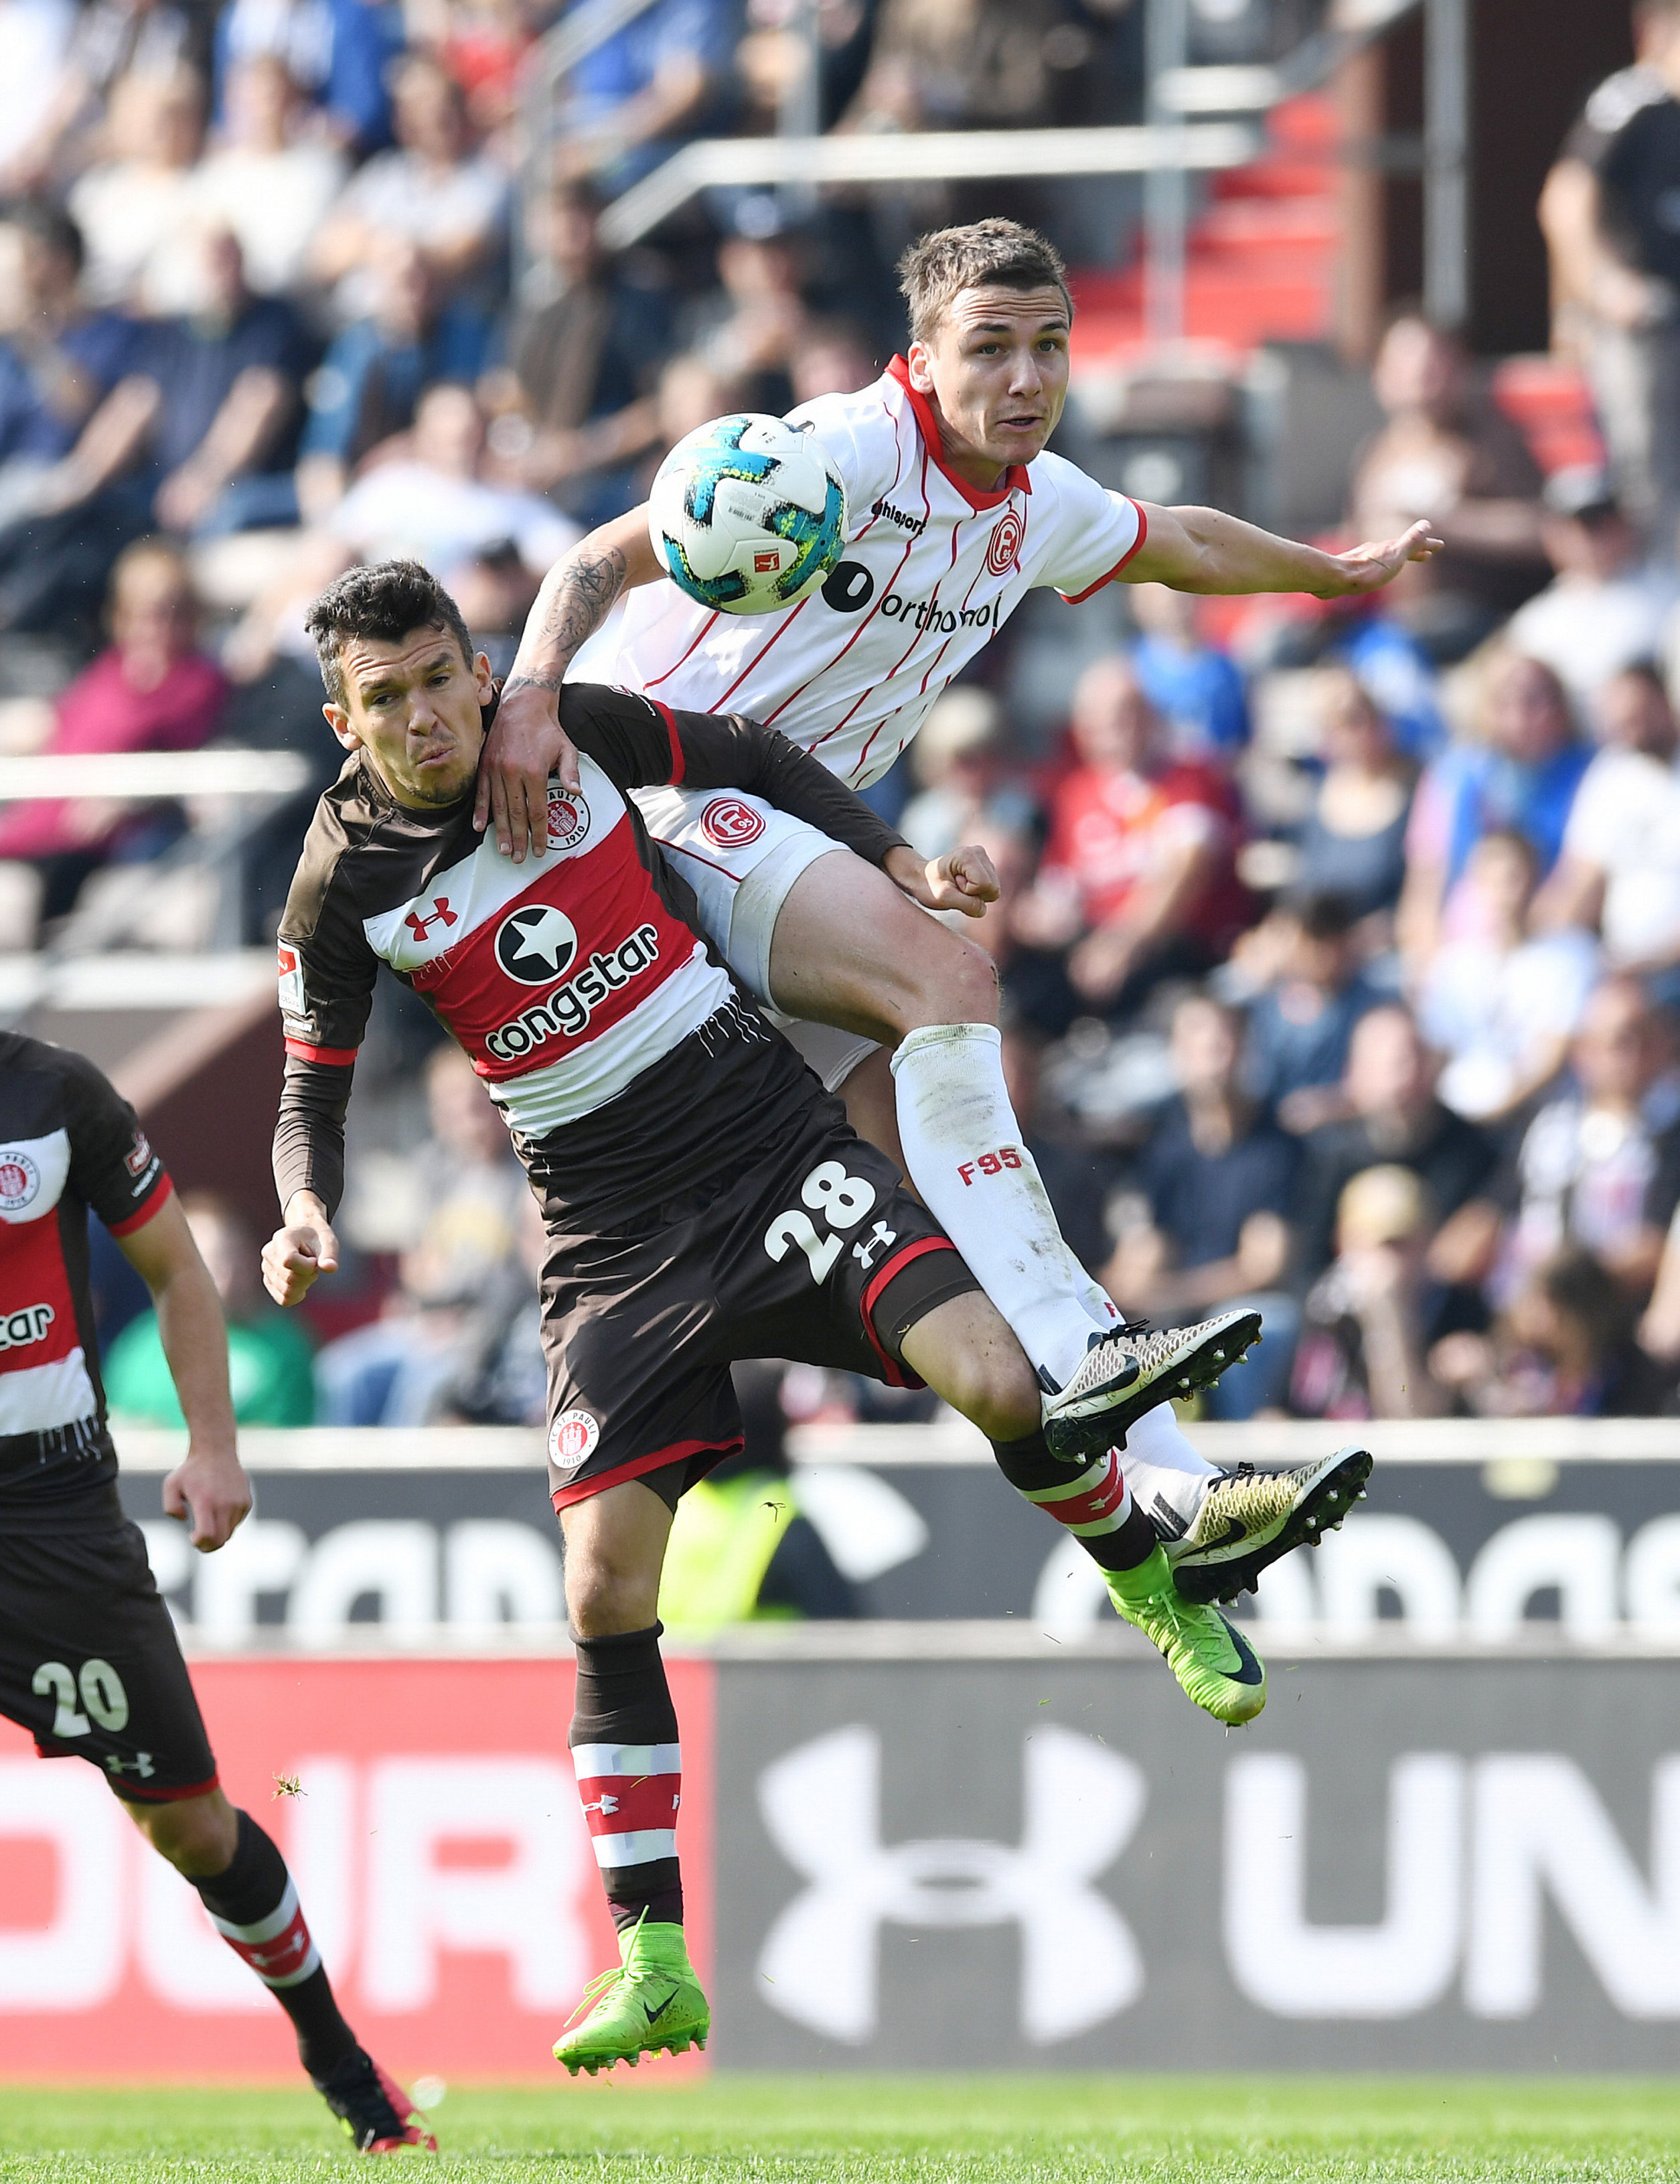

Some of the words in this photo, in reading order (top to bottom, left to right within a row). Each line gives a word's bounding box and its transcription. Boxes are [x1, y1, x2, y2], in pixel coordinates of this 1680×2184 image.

[871, 501, 927, 534] uhlsport
[550, 791, 577, 802] AULI
[565, 825, 585, 845] 1910
[487, 925, 658, 1060] congstar
[957, 1148, 1022, 1187] F95
[764, 1161, 876, 1286] 28
[0, 1305, 53, 1348] ar
[572, 1412, 597, 1434] PAULI
[562, 1455, 581, 1465] 1910
[31, 1658, 129, 1739] 20
